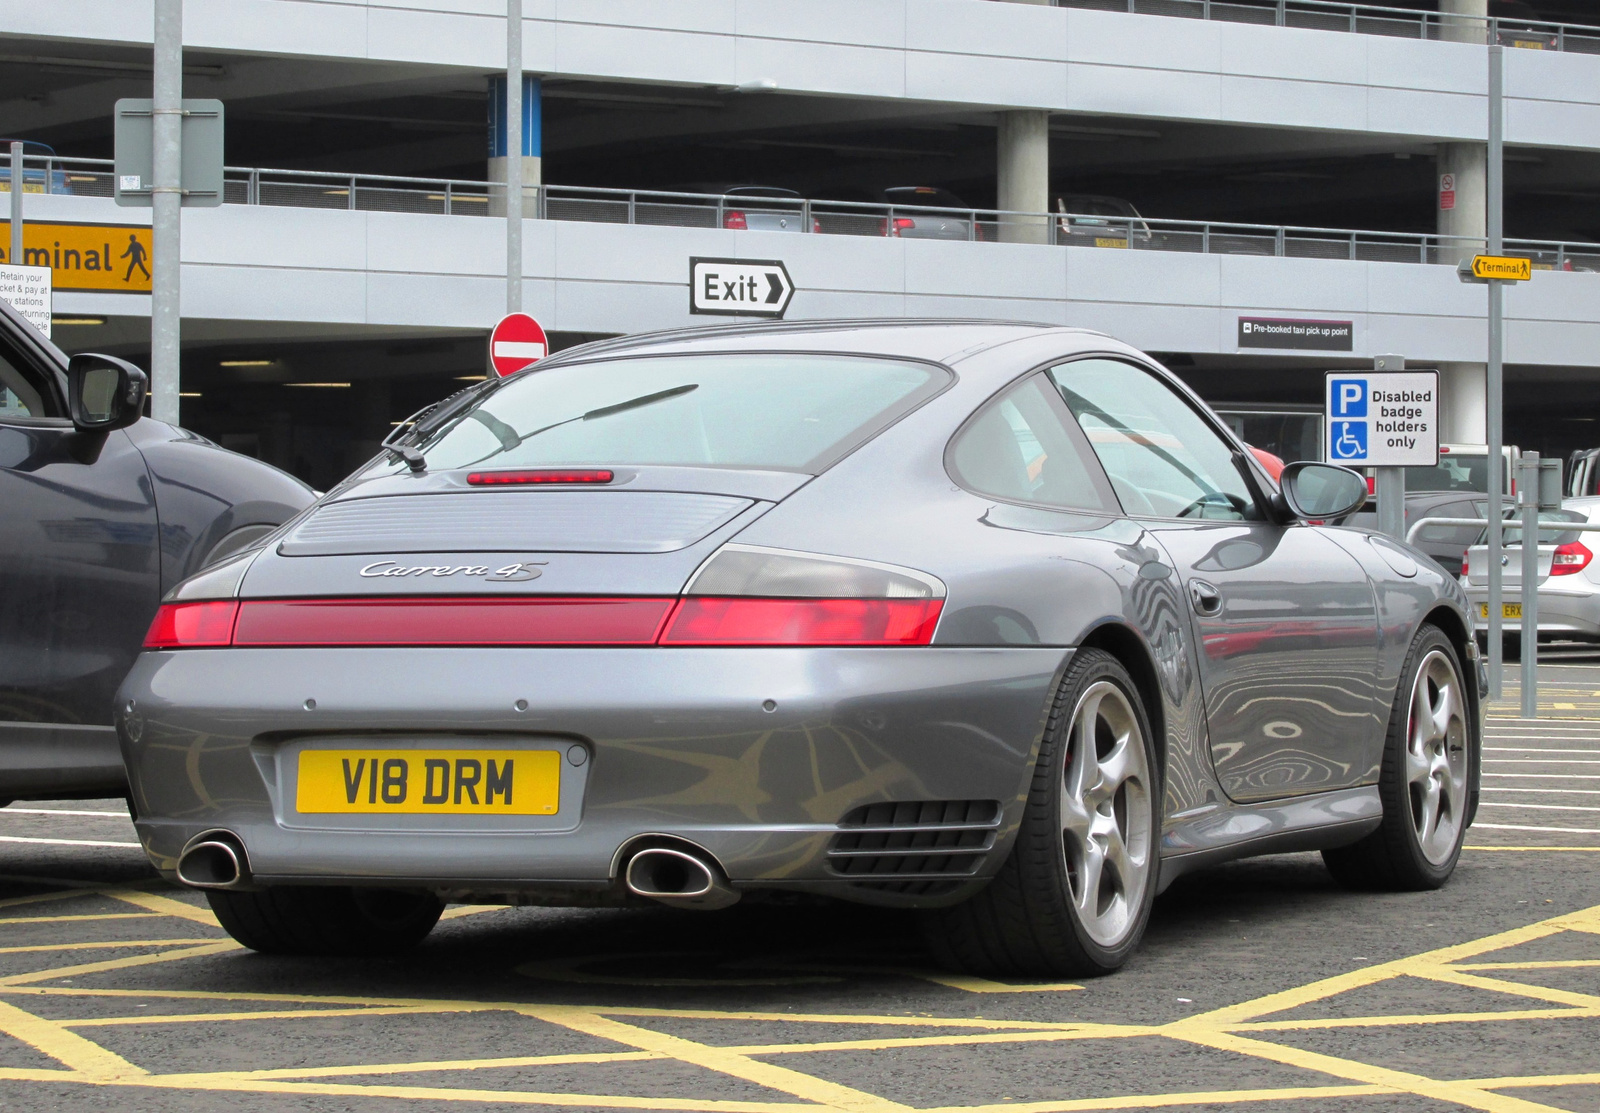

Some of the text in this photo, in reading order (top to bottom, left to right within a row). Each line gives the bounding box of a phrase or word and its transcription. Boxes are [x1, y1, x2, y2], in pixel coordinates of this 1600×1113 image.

[0, 241, 113, 272] minal
[1482, 261, 1520, 274] Terminal
[0, 271, 42, 283] Retain your
[0, 284, 16, 292] cket
[25, 286, 39, 295] pay
[704, 273, 758, 302] Exit
[4, 297, 44, 306] ay stations
[1253, 323, 1348, 337] Pre-booked taxi pick up point
[1340, 383, 1363, 414] P
[1372, 390, 1432, 402] Disabled
[1381, 405, 1423, 419] badge
[1376, 421, 1427, 432] holders
[1387, 435, 1416, 449] only
[359, 560, 549, 582] Carrera 4S
[1505, 605, 1522, 616] ERX
[342, 758, 514, 805] V18 DRM
